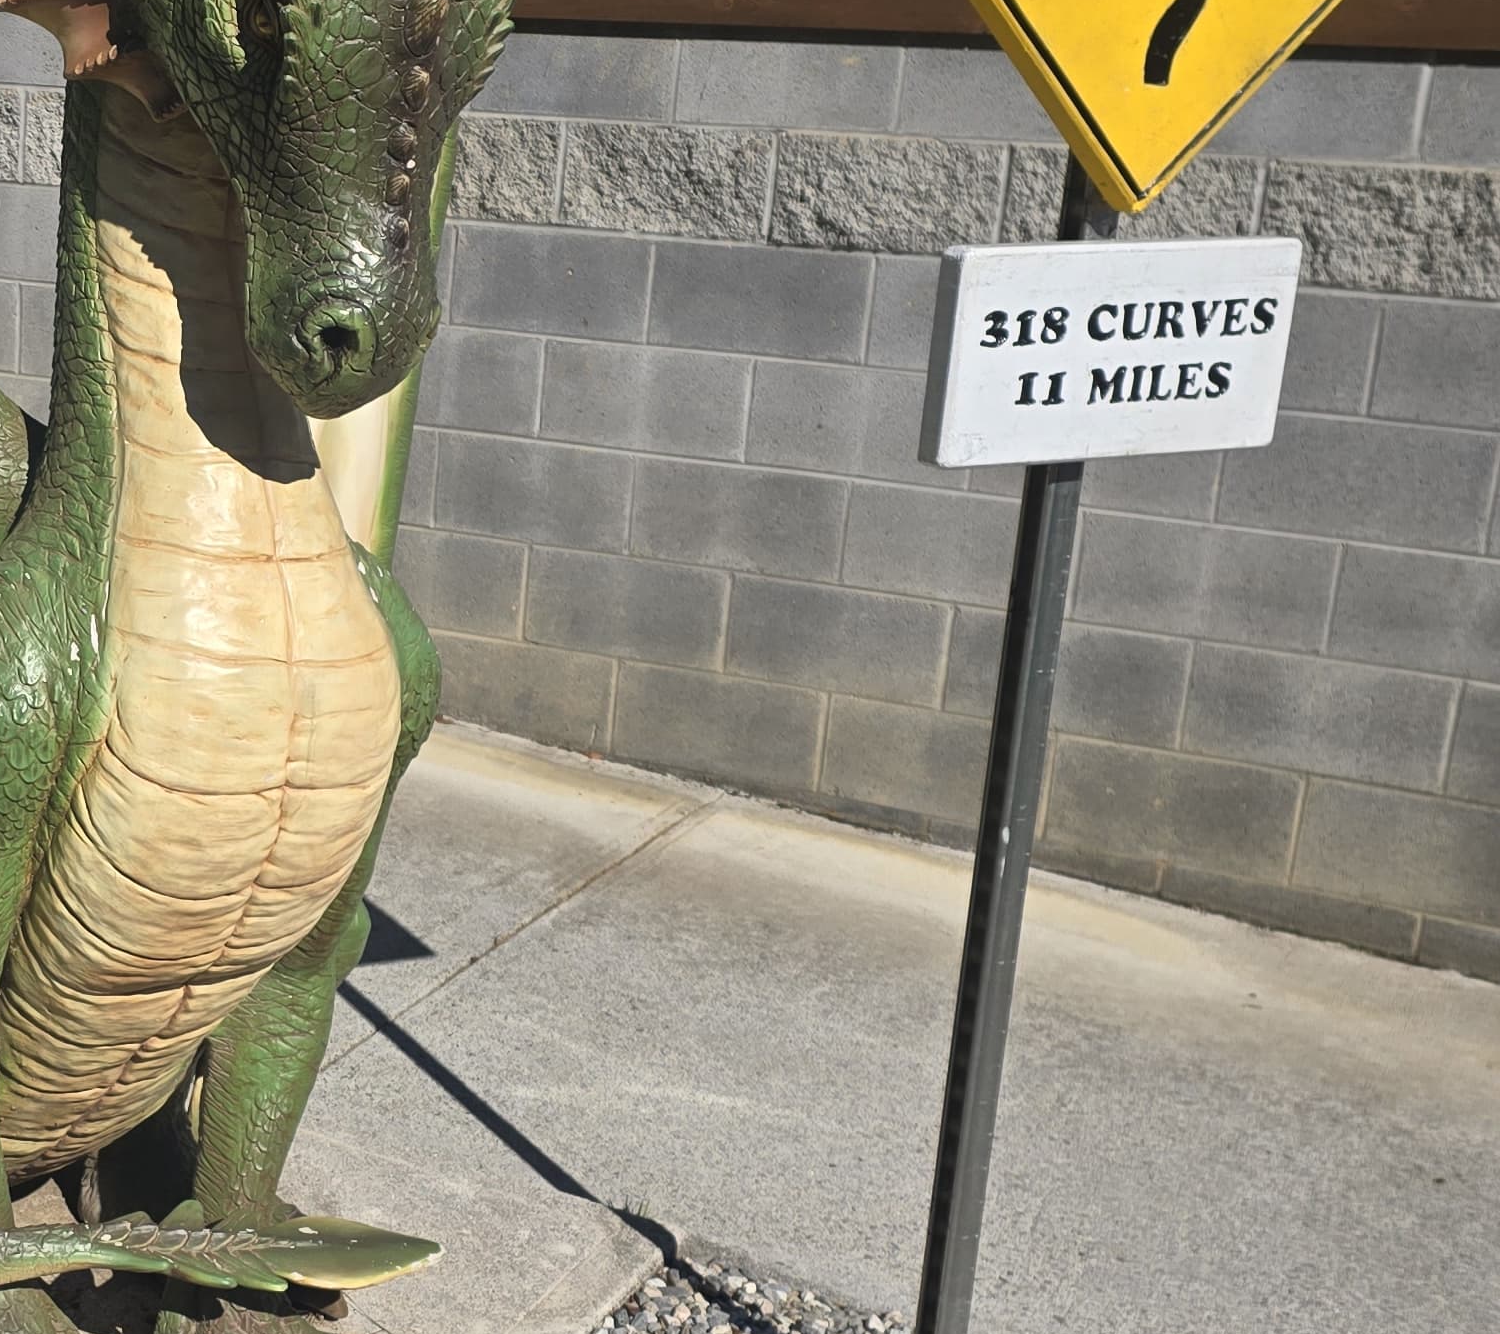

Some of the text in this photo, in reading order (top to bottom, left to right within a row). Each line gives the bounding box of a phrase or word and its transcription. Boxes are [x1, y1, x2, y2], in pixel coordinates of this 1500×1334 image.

[980, 298, 1279, 347] 318 CURVES
[1015, 362, 1232, 406] 11 MILES
